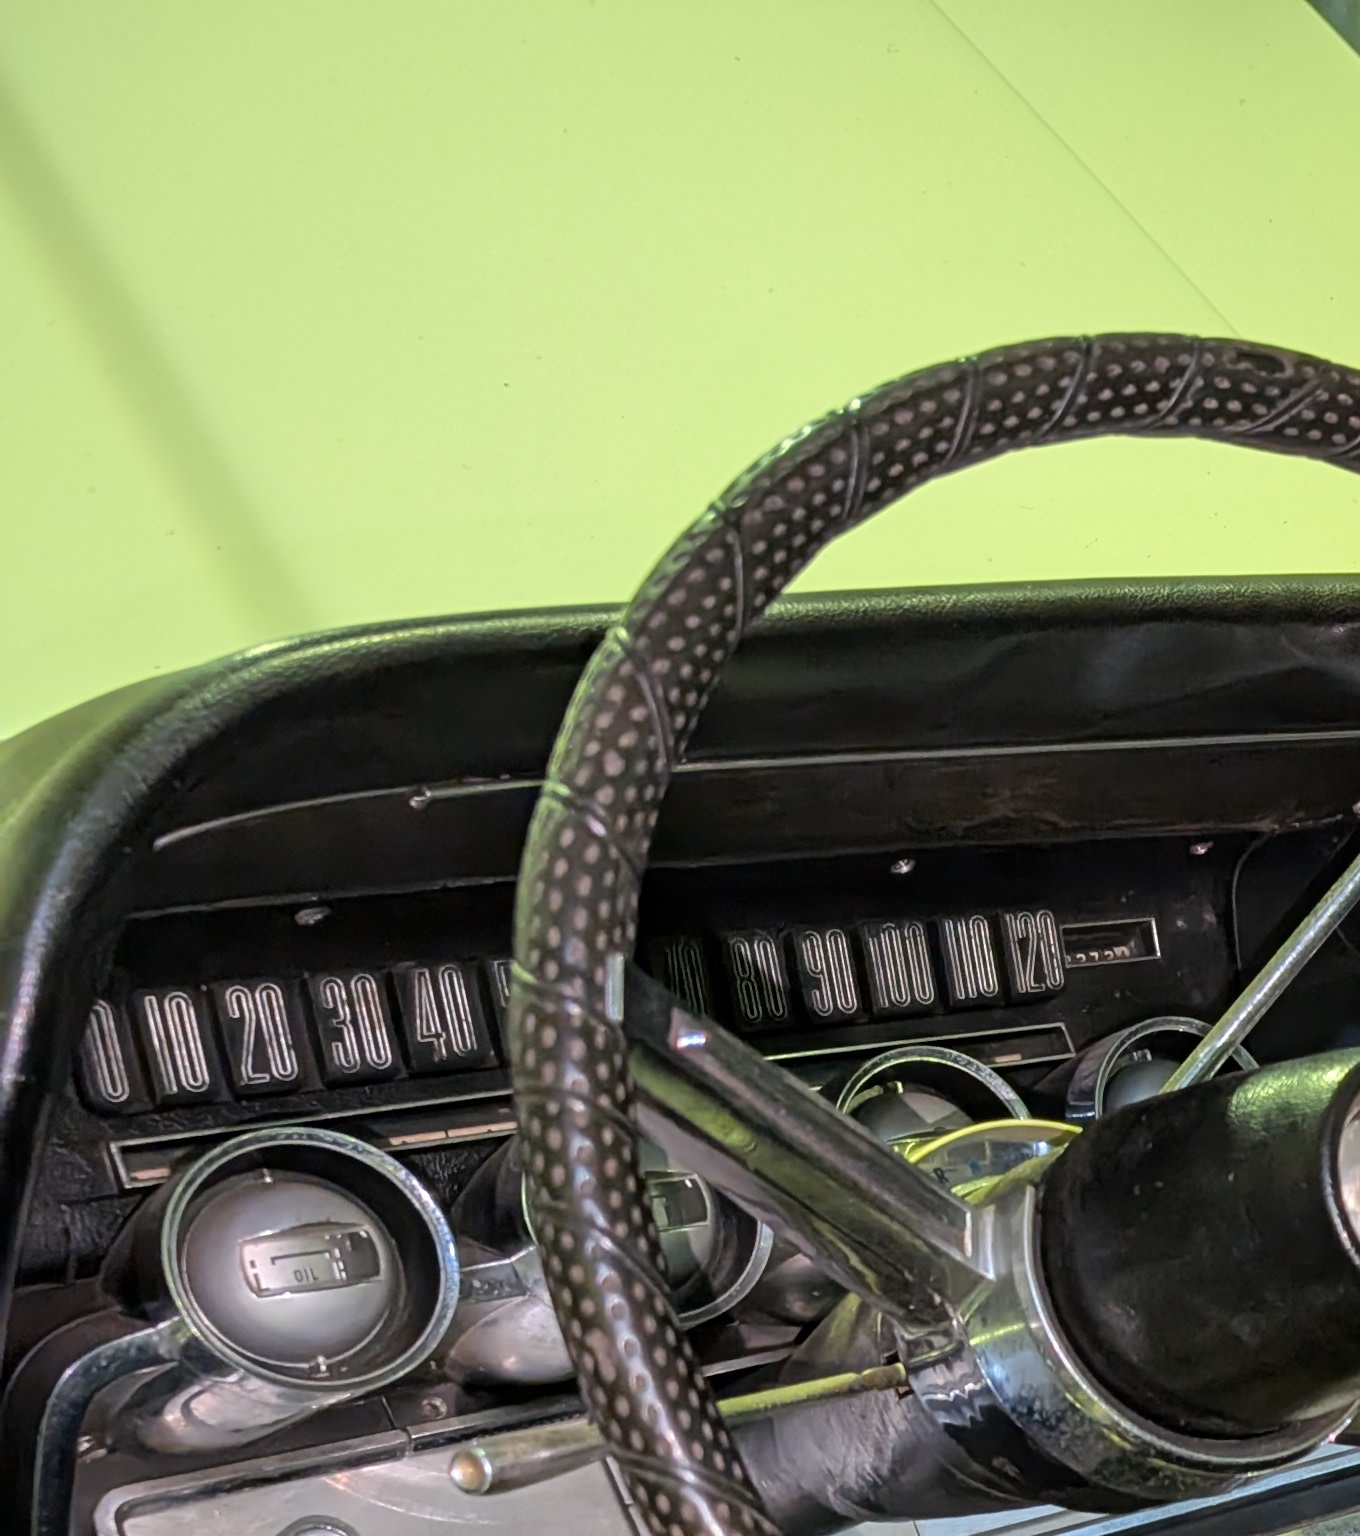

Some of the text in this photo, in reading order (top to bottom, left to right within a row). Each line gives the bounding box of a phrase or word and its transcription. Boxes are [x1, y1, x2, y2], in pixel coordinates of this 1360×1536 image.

[730, 931, 788, 1024] 80
[802, 928, 857, 1017] 90
[868, 922, 934, 1008] 100
[945, 915, 999, 1000] 110
[1004, 909, 1065, 994] 120
[143, 990, 210, 1094] 10
[225, 982, 299, 1085] 20
[319, 973, 393, 1074] 30
[414, 964, 478, 1062] 40
[293, 1267, 320, 1283] OIL
